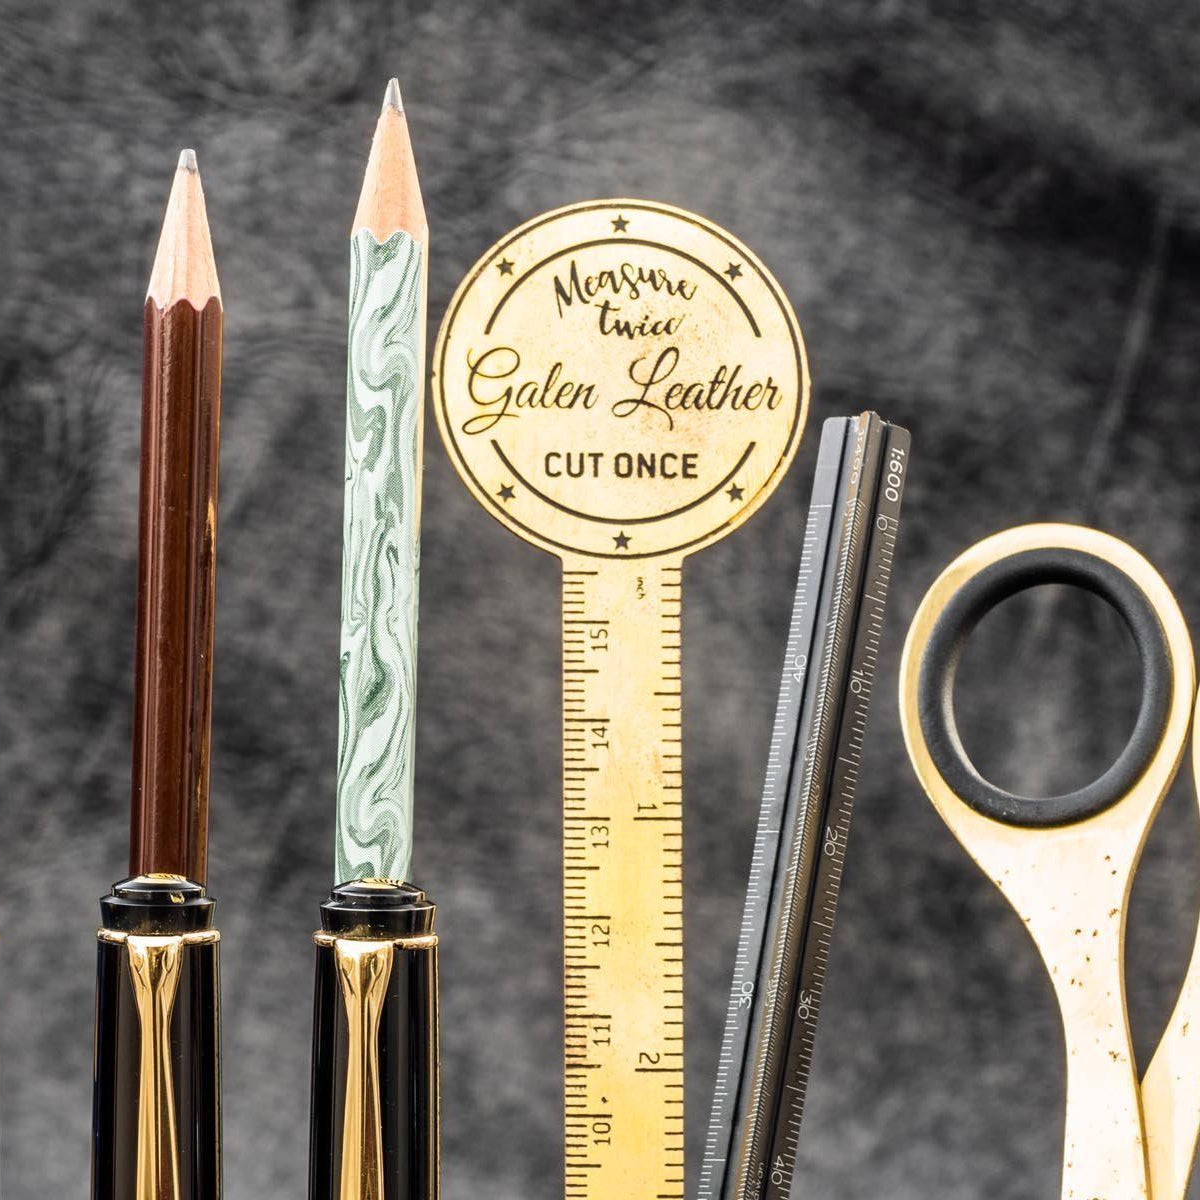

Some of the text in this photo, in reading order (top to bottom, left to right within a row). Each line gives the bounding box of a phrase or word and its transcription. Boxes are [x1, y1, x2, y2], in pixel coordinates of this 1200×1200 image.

[553, 261, 697, 318] Measure
[463, 347, 783, 435] Galen Leather
[545, 452, 698, 479] CUT ONCE
[886, 448, 905, 501] 1:600
[591, 629, 607, 650] 15
[793, 655, 807, 683] 40
[851, 670, 863, 693] 10
[592, 727, 608, 748] 14
[638, 804, 657, 812] 1
[591, 826, 609, 848] 13
[825, 827, 838, 856] 20
[592, 925, 610, 946] 12
[739, 982, 754, 1008] 30
[798, 991, 812, 1019] 30
[593, 1025, 610, 1045] 11
[639, 1053, 660, 1064] 2
[593, 1122, 611, 1144] 10
[771, 1156, 784, 1185] 40
